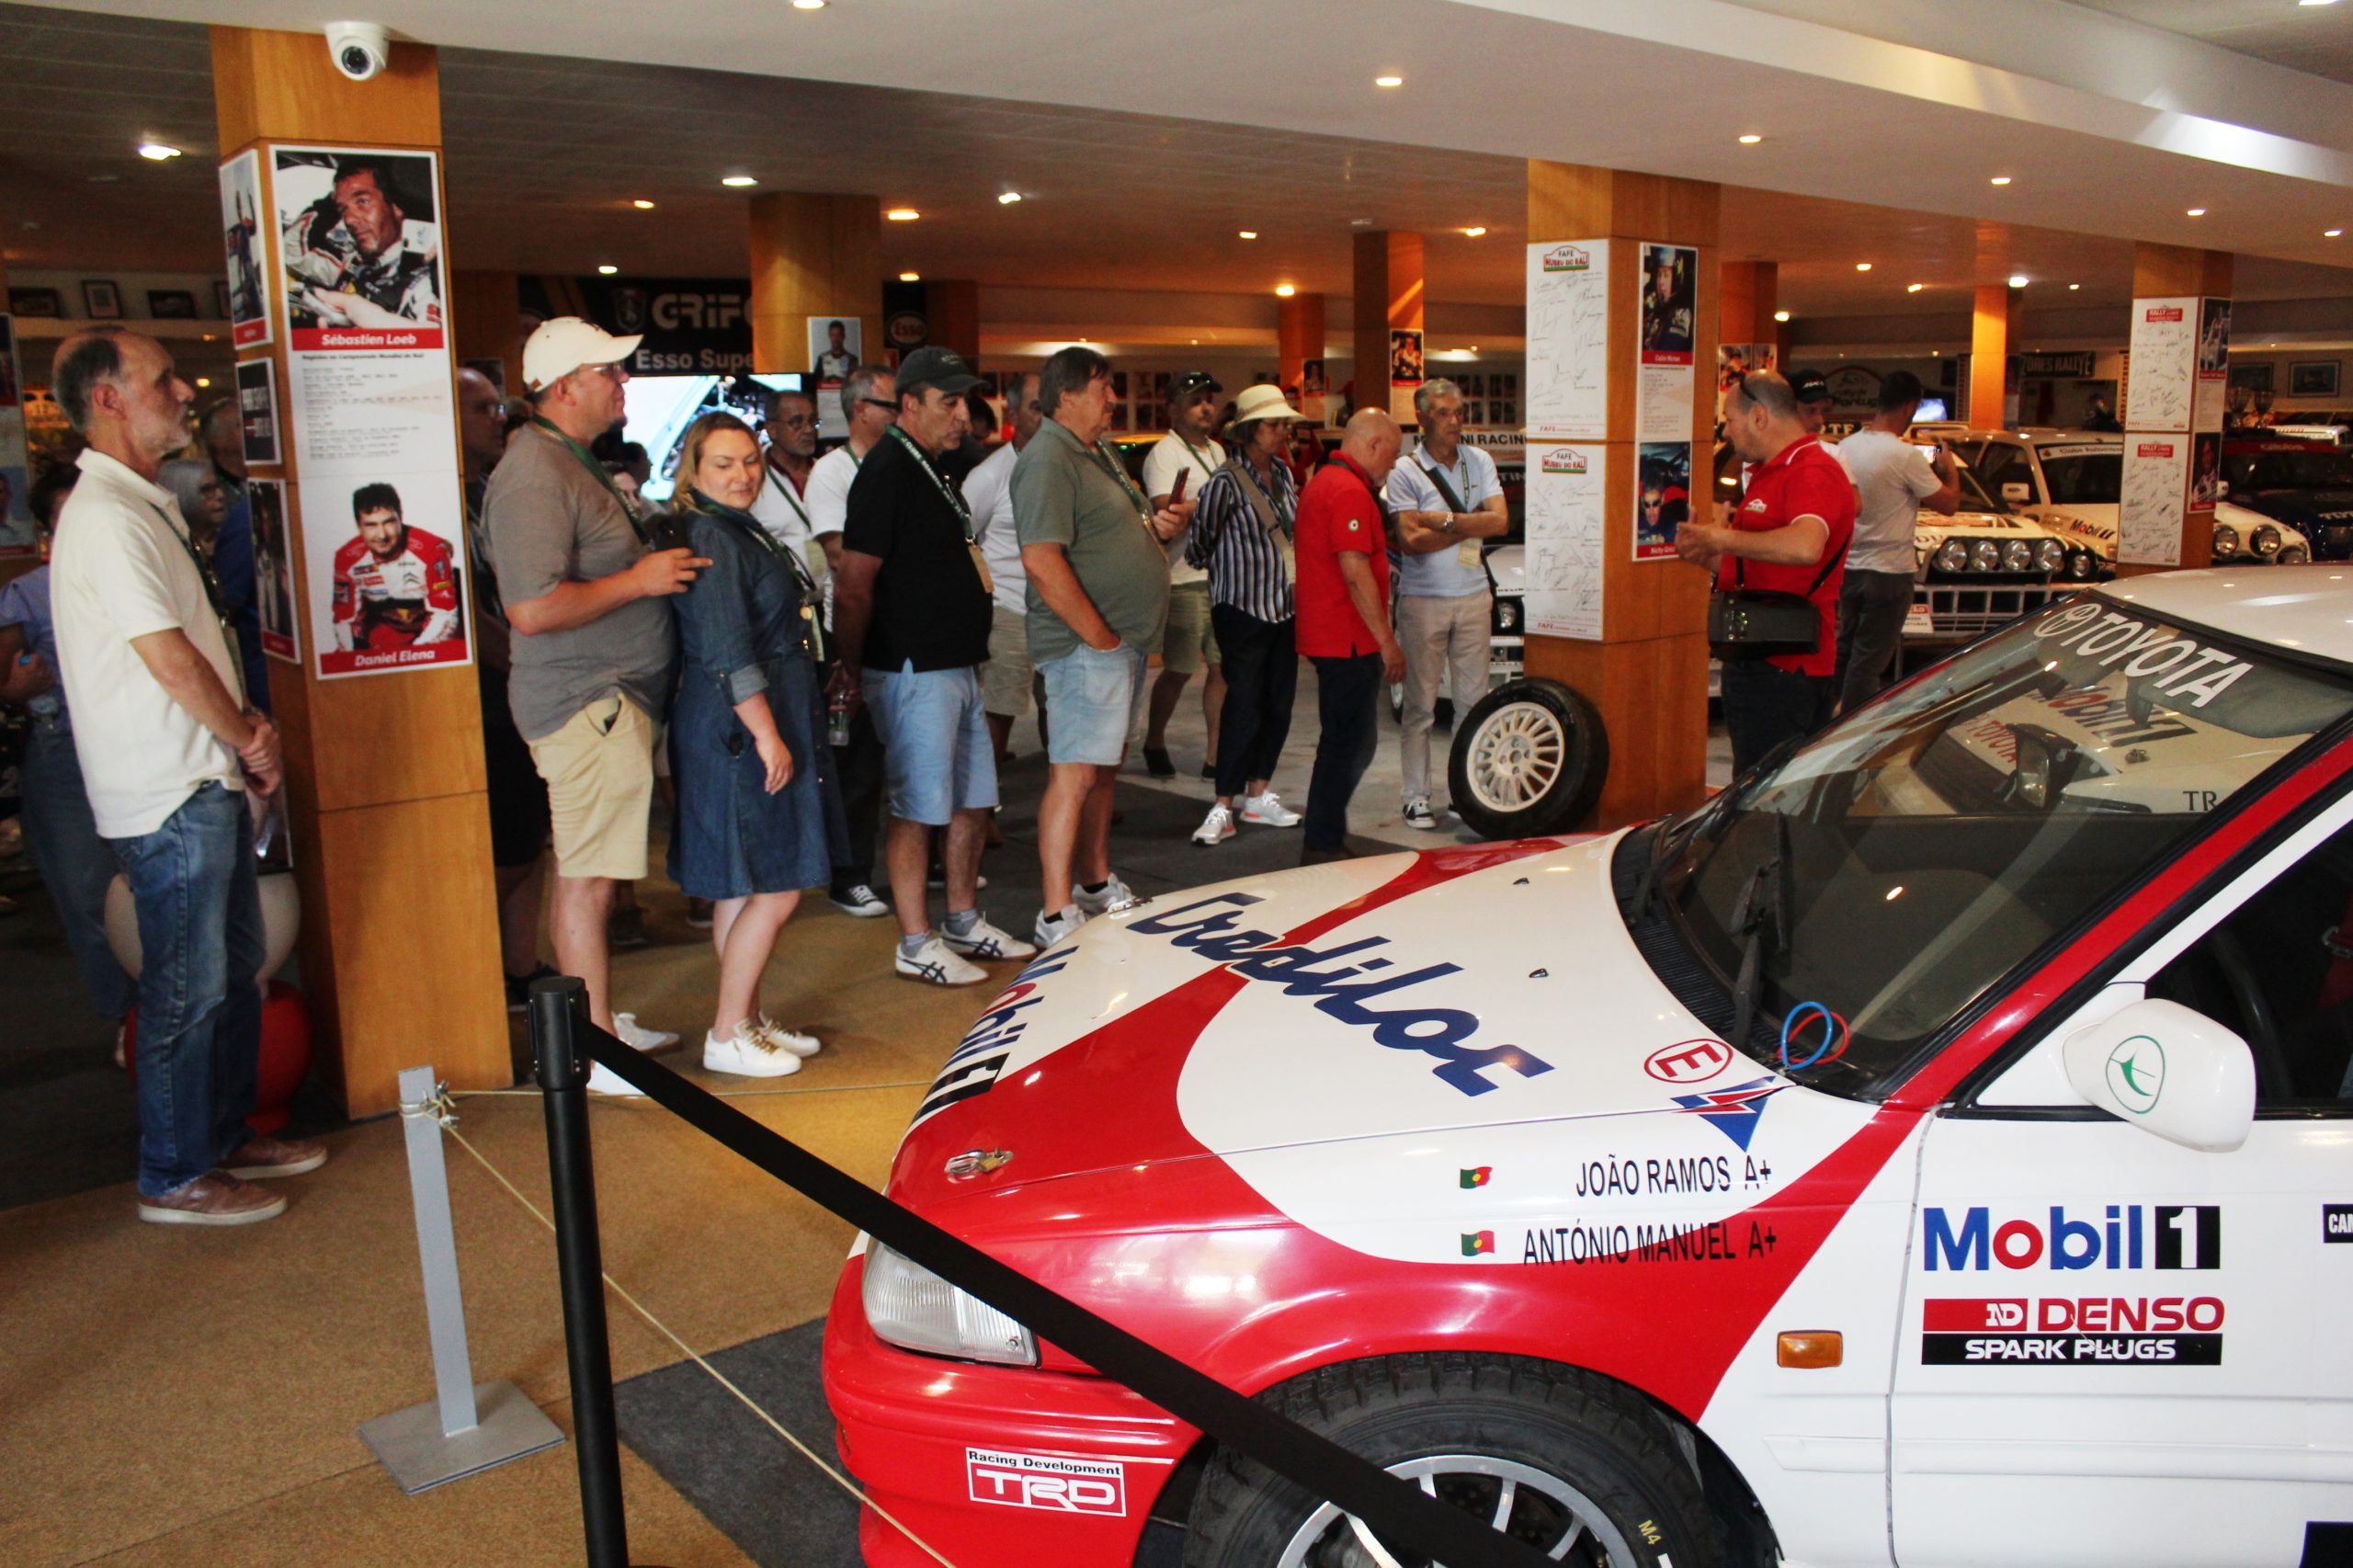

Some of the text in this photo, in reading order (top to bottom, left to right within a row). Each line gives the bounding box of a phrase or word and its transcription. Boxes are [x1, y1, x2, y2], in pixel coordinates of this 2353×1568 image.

[1545, 256, 1564, 266] MUSEU
[322, 333, 416, 346] Sébastien Loeb
[636, 348, 693, 369] Esso
[1543, 460, 1563, 468] MUSEU
[2070, 518, 2101, 536] Mobil
[355, 648, 435, 666] Daniel Elena
[2061, 613, 2253, 708] TOYOTA
[1654, 1043, 1723, 1078] E
[1576, 1153, 1772, 1197] JOÃO RAMOS A+
[1524, 1218, 1777, 1266] ANTÓNIO MANUEL A+
[1923, 1205, 2143, 1271] Mobil
[2038, 1297, 2225, 1333] DENSO
[1965, 1339, 2176, 1360] SPARK PLUGS
[969, 1450, 1120, 1475] Racing Development
[976, 1469, 1116, 1511] TRD
[1638, 1520, 1662, 1546] M4
